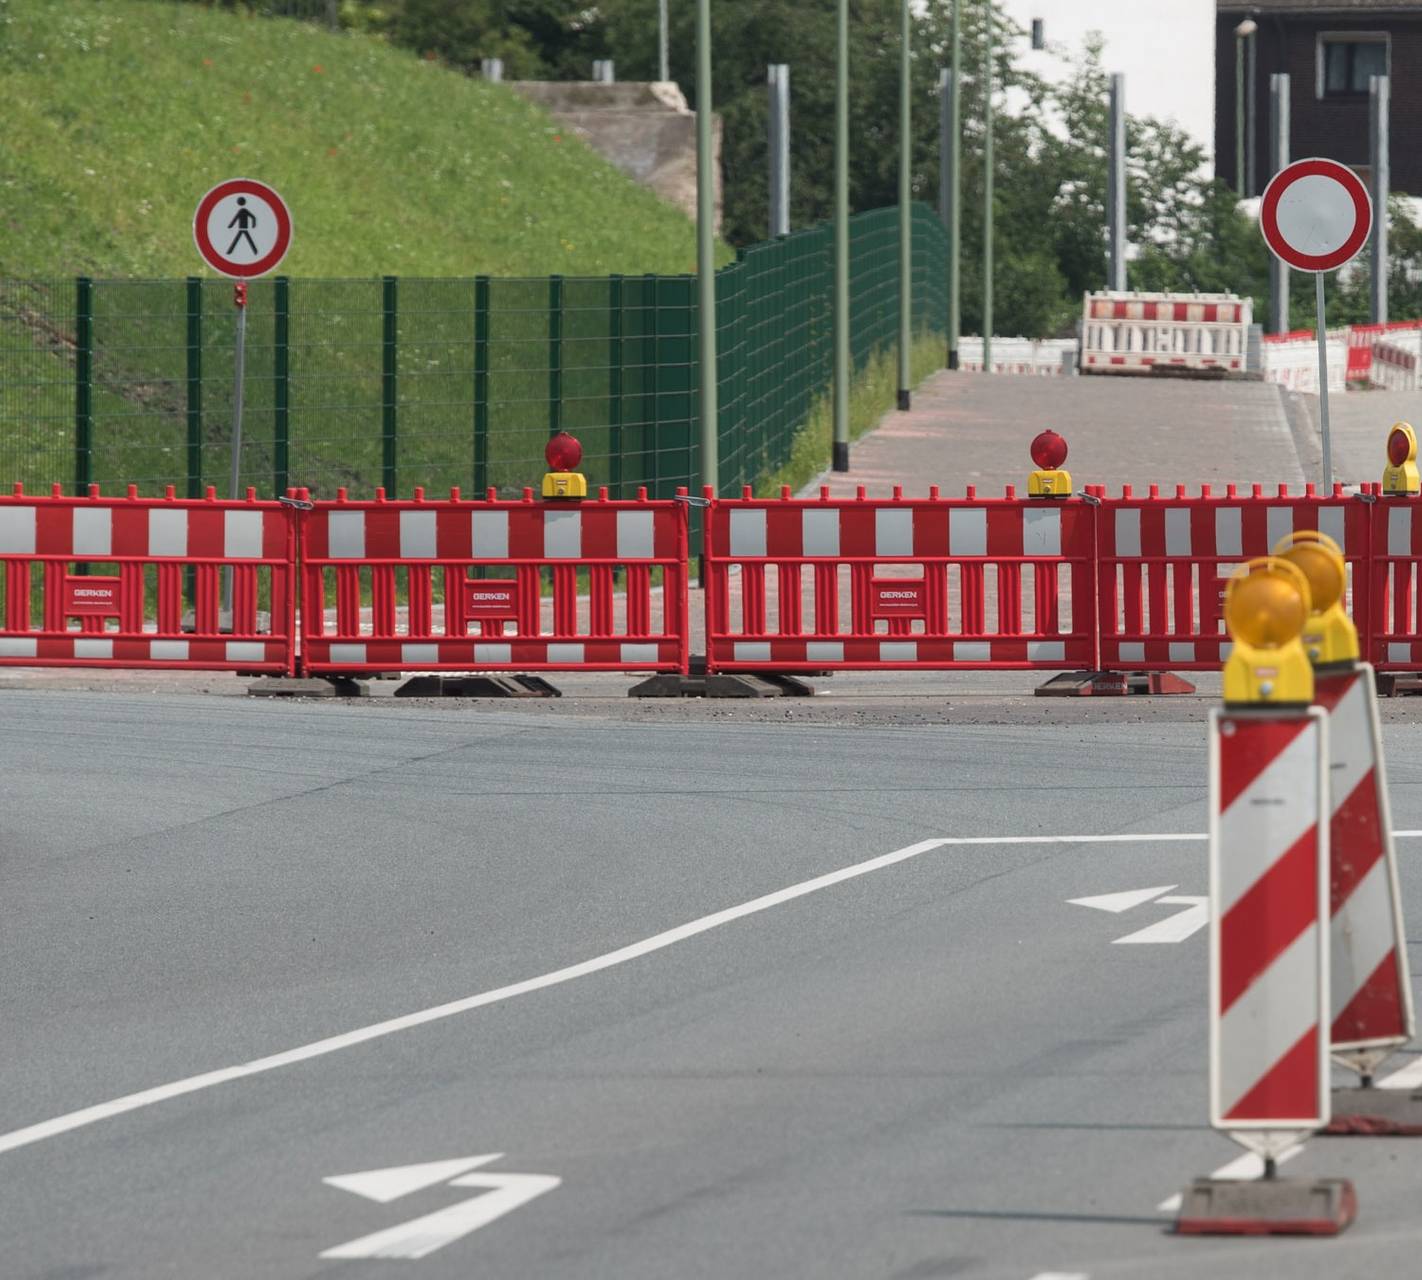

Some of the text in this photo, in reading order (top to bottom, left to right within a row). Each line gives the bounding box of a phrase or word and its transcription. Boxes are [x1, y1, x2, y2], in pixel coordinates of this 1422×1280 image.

[74, 589, 112, 597] GERKEN
[473, 592, 510, 600] GERKEN
[880, 591, 918, 599] GERKEN
